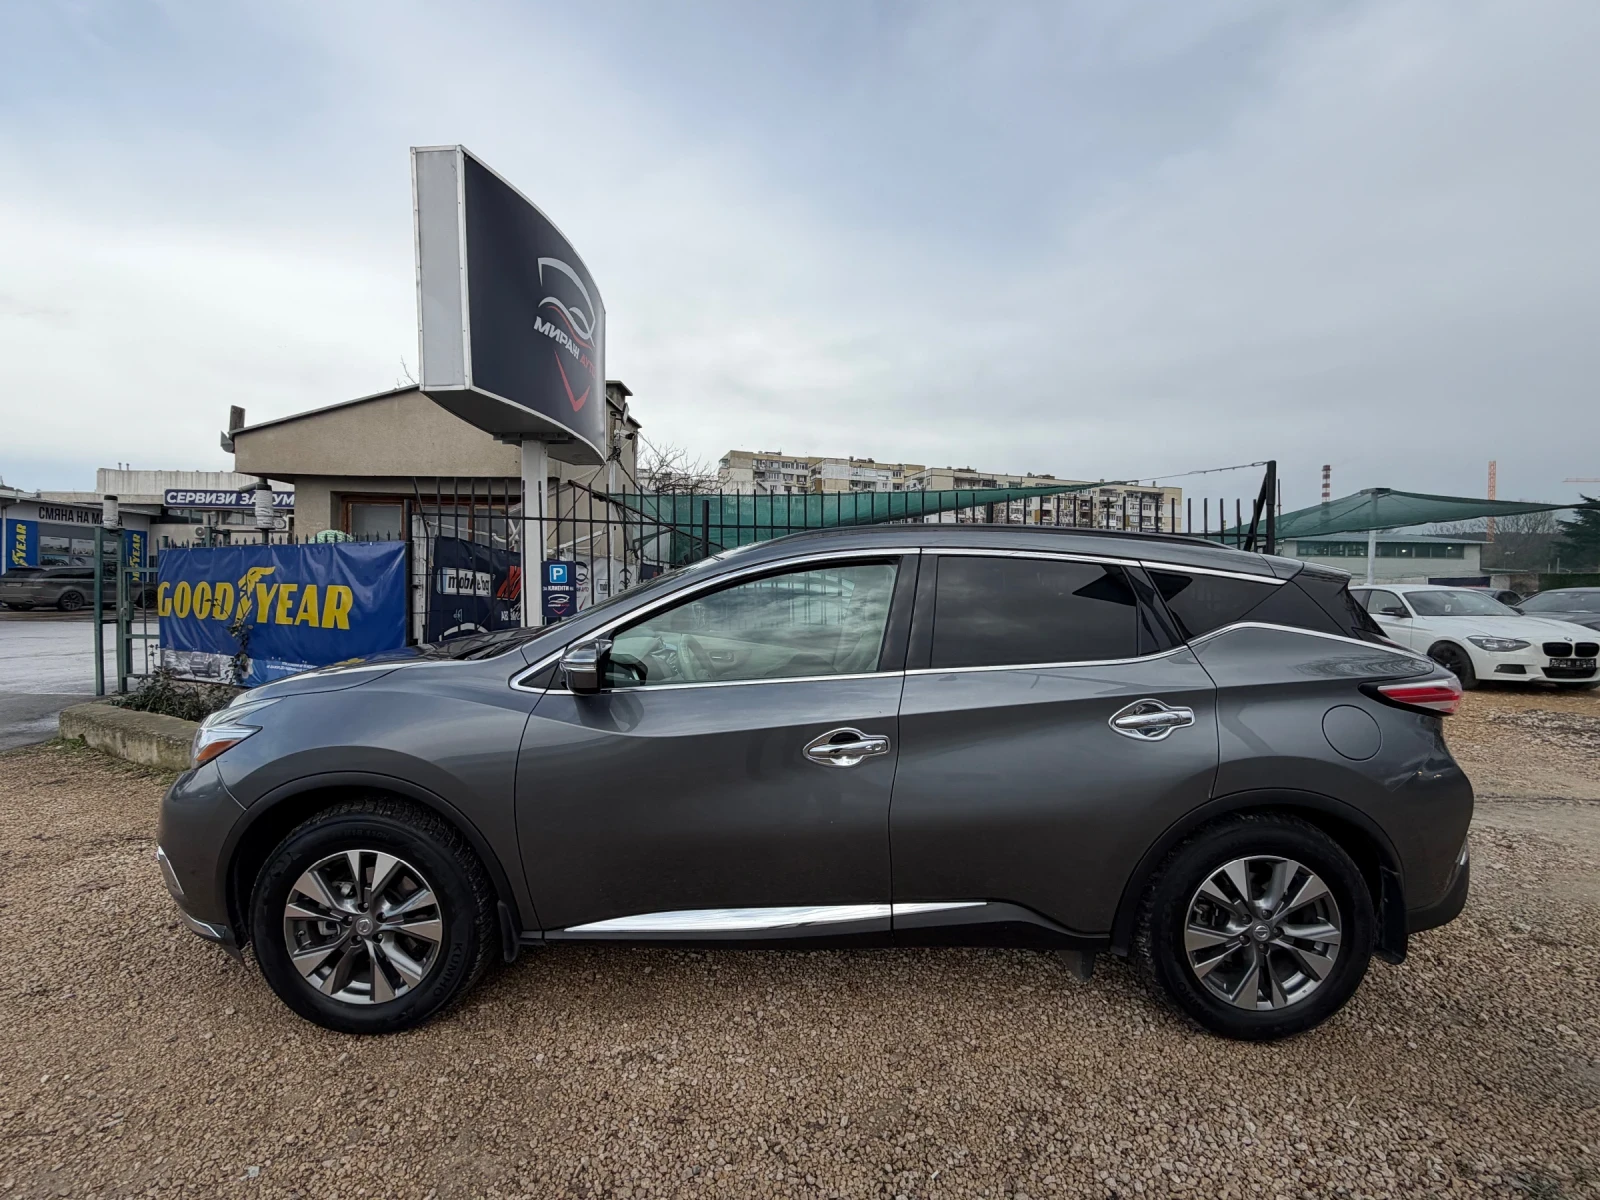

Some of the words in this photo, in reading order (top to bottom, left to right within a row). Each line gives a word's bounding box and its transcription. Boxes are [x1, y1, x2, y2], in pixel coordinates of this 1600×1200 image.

[533, 315, 580, 360] МИРАЖ
[166, 492, 237, 505] СЕРВИЗИ
[38, 506, 74, 522] СМЯНА
[76, 512, 90, 524] НА
[91, 513, 124, 527] МАА
[552, 567, 564, 580] P
